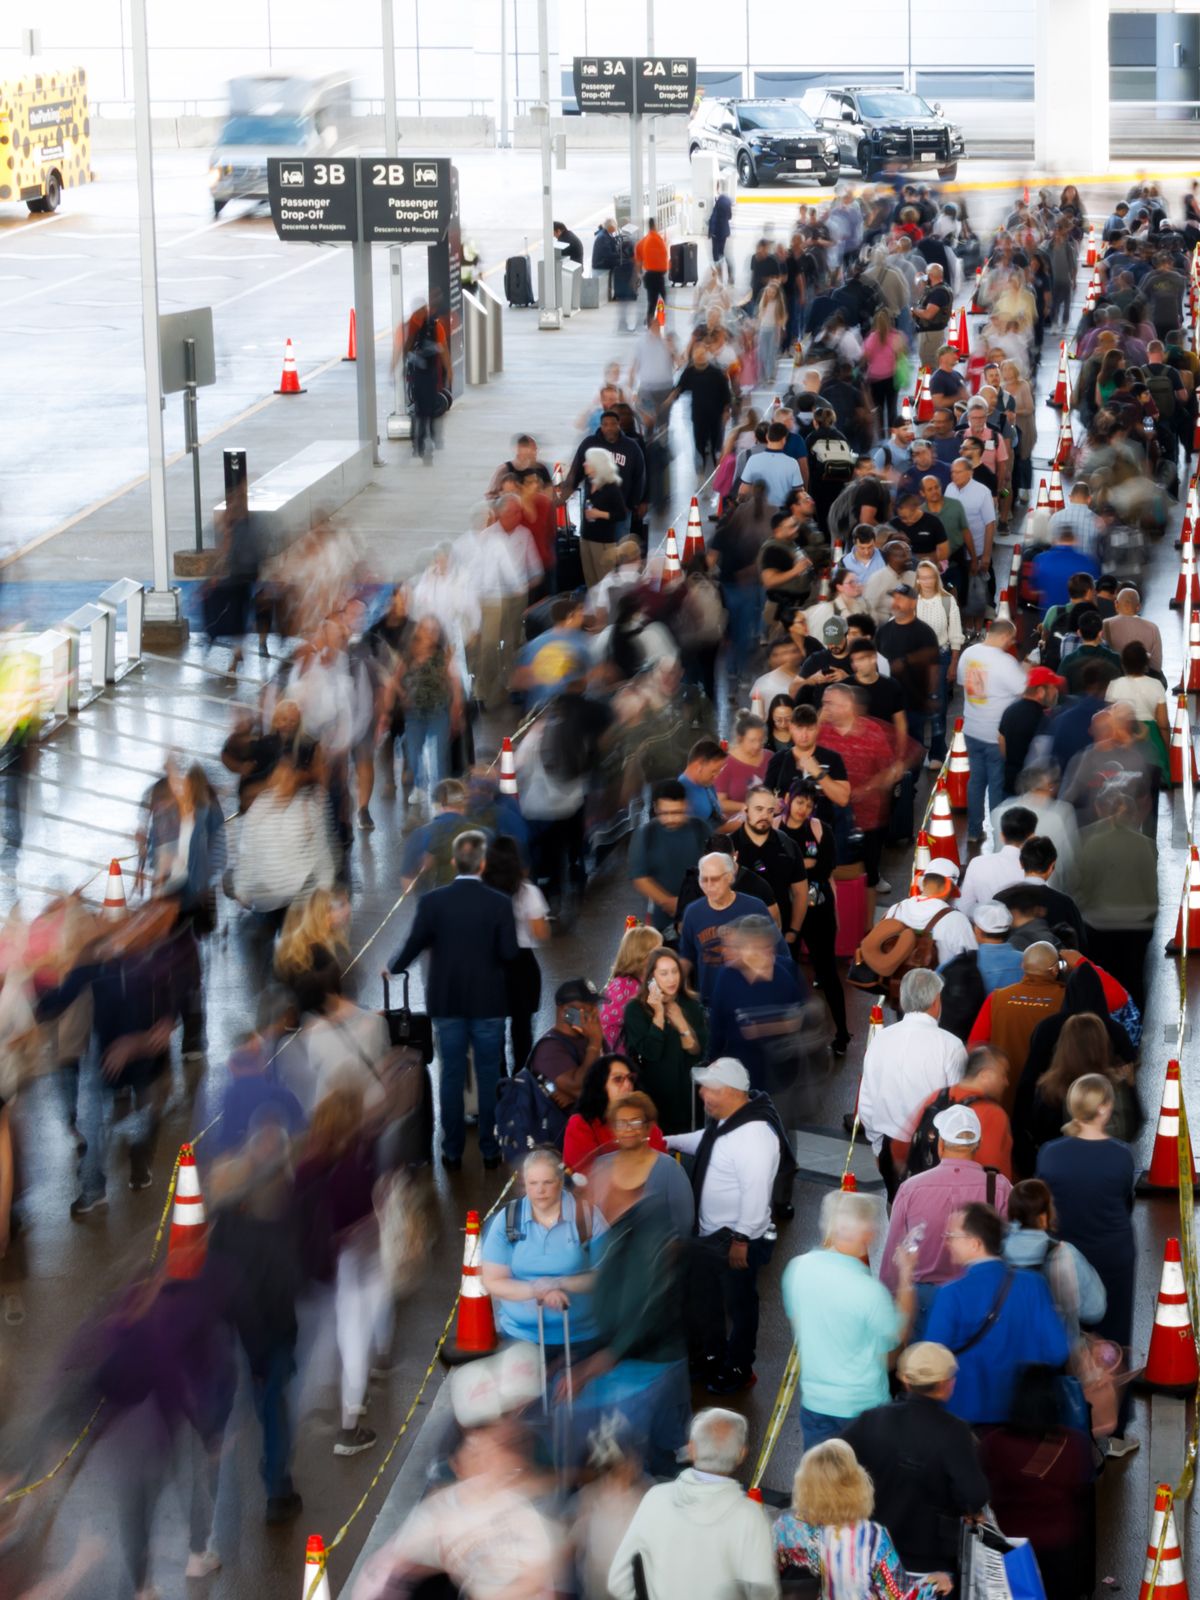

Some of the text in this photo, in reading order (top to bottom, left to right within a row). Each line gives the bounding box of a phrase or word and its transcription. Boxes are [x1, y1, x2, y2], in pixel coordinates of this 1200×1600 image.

[603, 60, 626, 76] 3A
[643, 61, 666, 76] 2A
[581, 83, 615, 91] Passenger
[654, 83, 688, 92] Passenger
[581, 91, 611, 99] Drop-Off
[659, 92, 688, 100] Drop-Off
[313, 164, 346, 185] 3B
[372, 164, 405, 186] 2B
[280, 198, 330, 208] Passenger
[388, 198, 438, 209] Passenger
[280, 210, 324, 221] Drop-Off
[396, 210, 439, 221] Drop-Off
